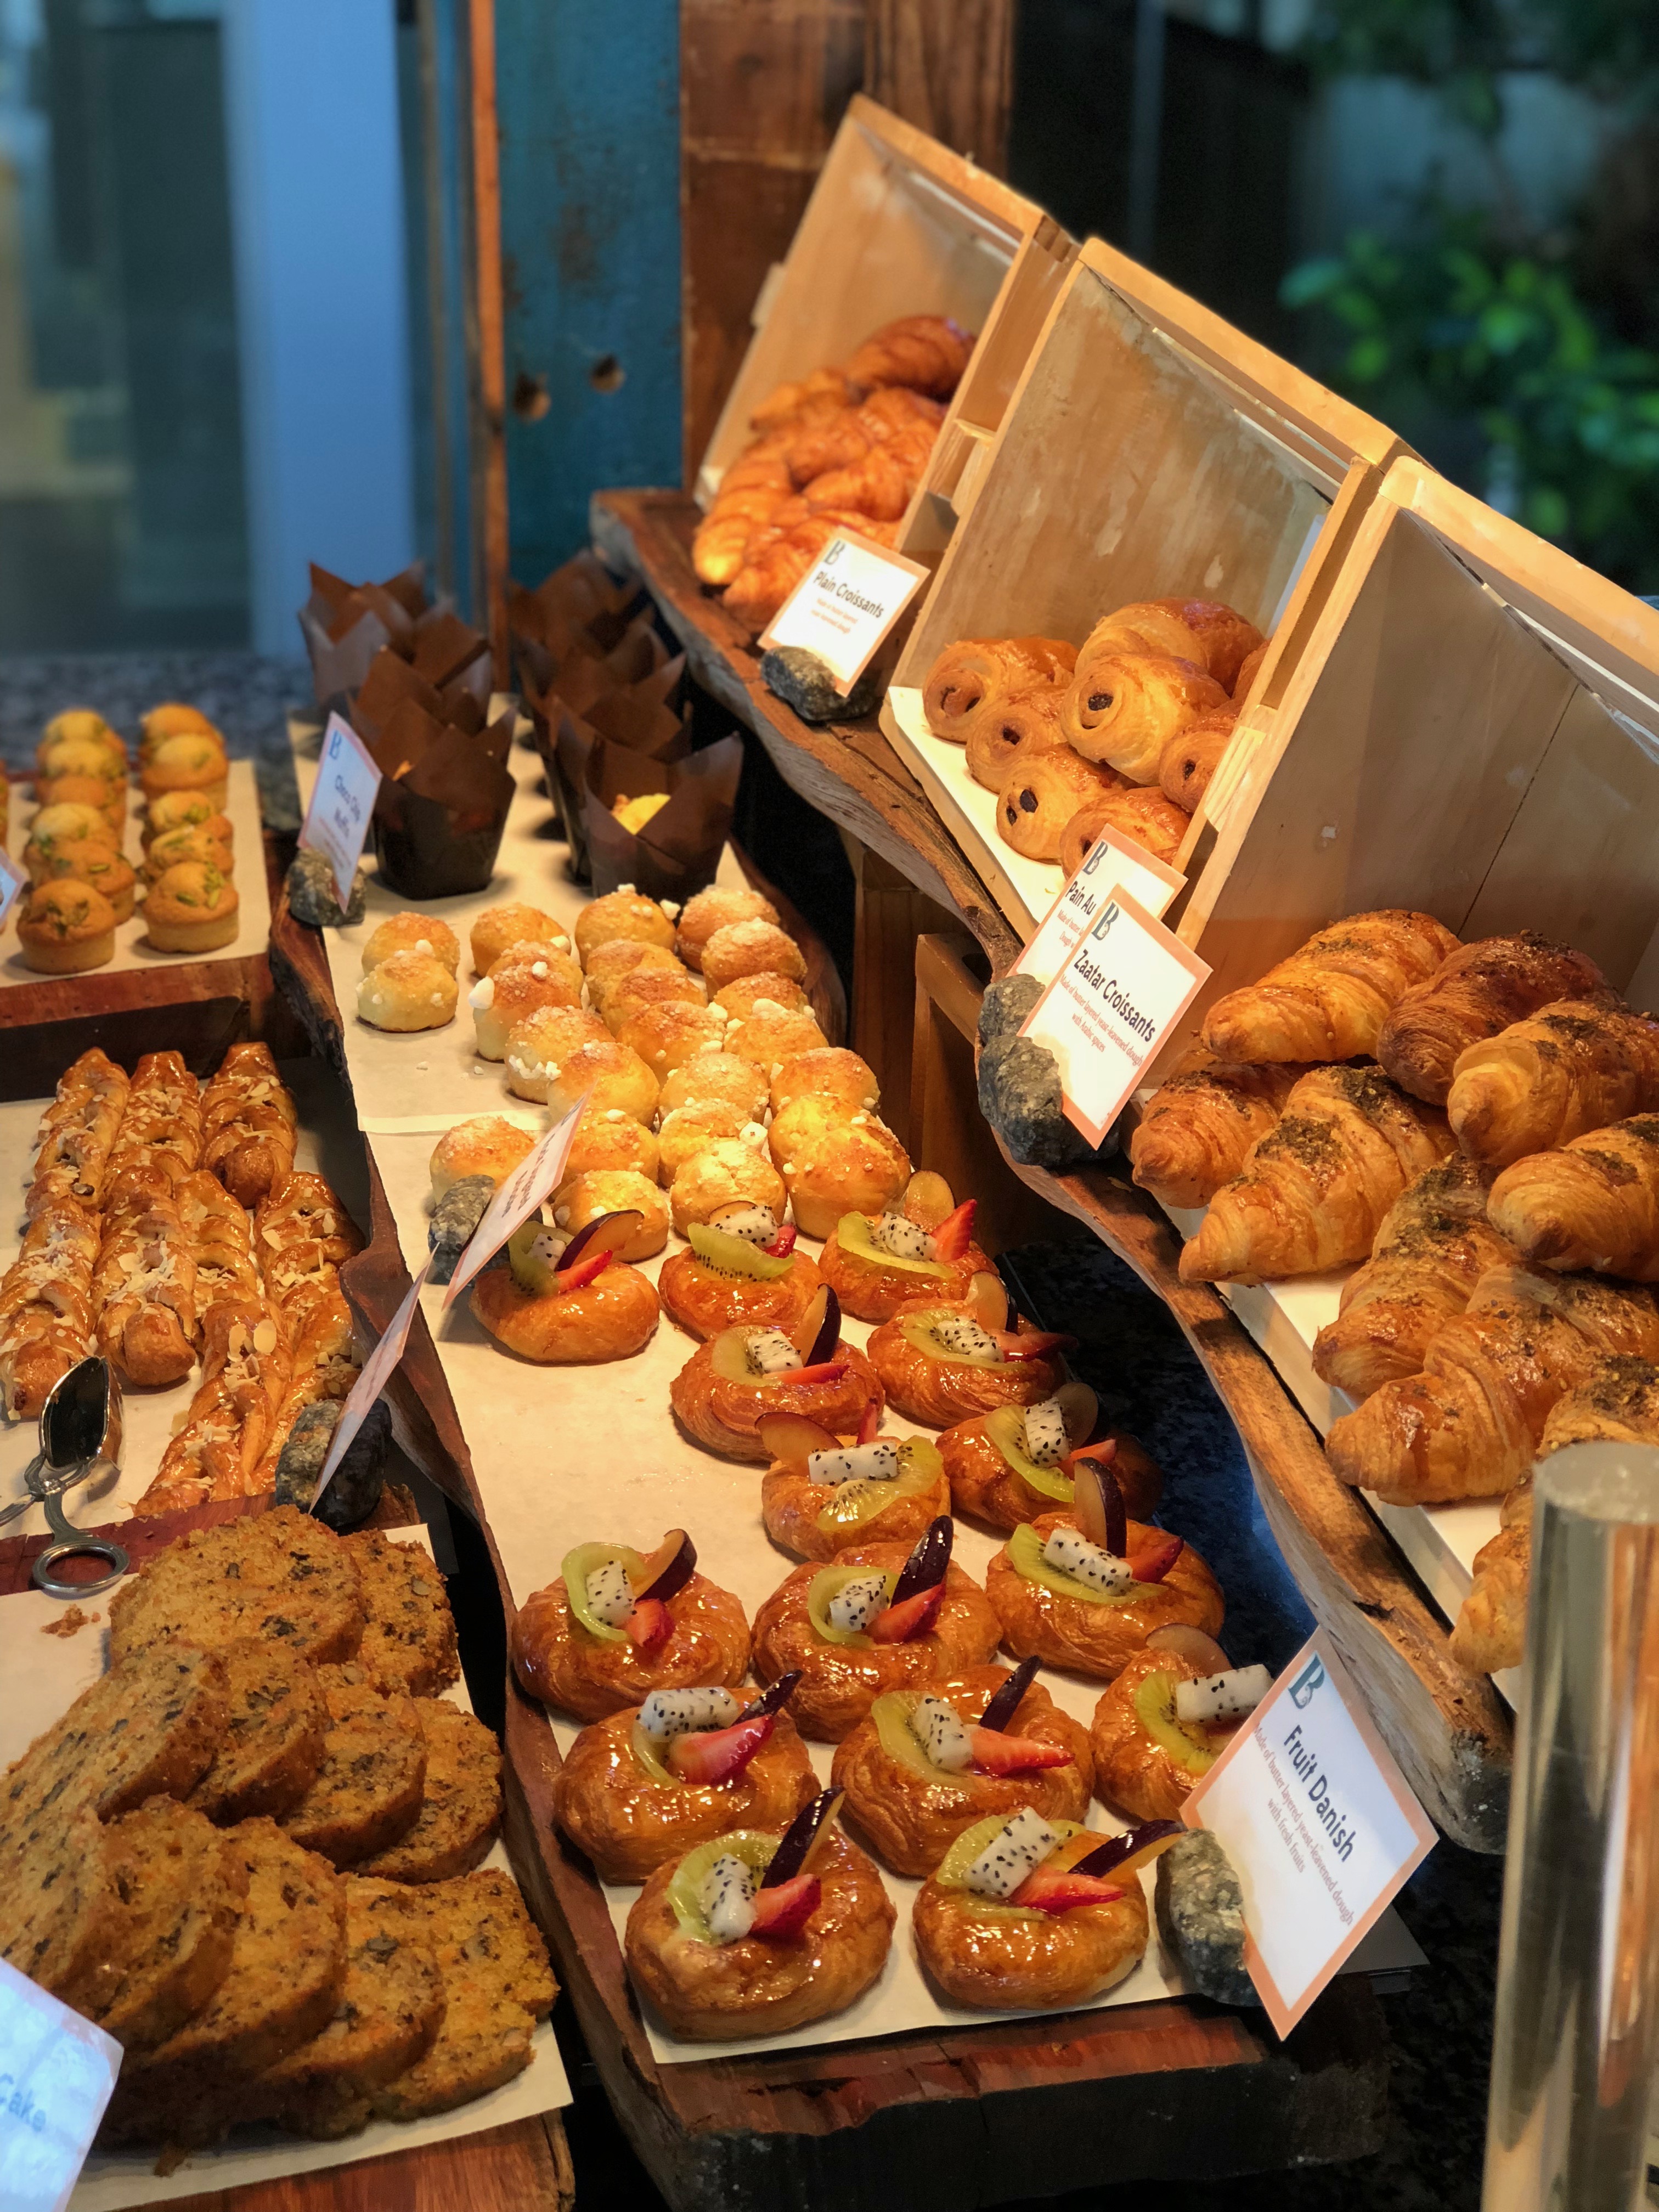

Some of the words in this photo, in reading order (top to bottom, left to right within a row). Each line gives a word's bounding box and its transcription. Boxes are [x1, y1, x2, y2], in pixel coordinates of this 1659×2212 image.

[813, 571, 837, 592] Plain
[836, 583, 884, 618] Croissants
[1082, 841, 1108, 876] B
[1065, 880, 1085, 907] Pain
[1081, 893, 1097, 916] Au
[1091, 901, 1119, 941] B
[1074, 949, 1106, 991] Zaatar
[1103, 979, 1156, 1042] Croissants
[1068, 986, 1077, 995] of
[1073, 988, 1086, 1007] butter
[1083, 1000, 1101, 1022] layered
[1126, 1046, 1144, 1067] dough
[1071, 1013, 1083, 1026] with
[1080, 1021, 1094, 1040] Arabic
[1091, 1036, 1106, 1053] spices
[1287, 1654, 1325, 1709] B
[1254, 1722, 1267, 1752] Made
[1263, 1750, 1275, 1762] of
[1268, 1756, 1285, 1790] butter
[1281, 1784, 1304, 1824] layered
[1284, 1724, 1318, 1784] Fruit
[1308, 1774, 1357, 1863] Danish
[1267, 1798, 1282, 1822] with
[1278, 1818, 1294, 1847] fresh
[1289, 1842, 1306, 1874] fruits
[1295, 1820, 1339, 1893] yeast-leavened
[1333, 1889, 1355, 1926] dough
